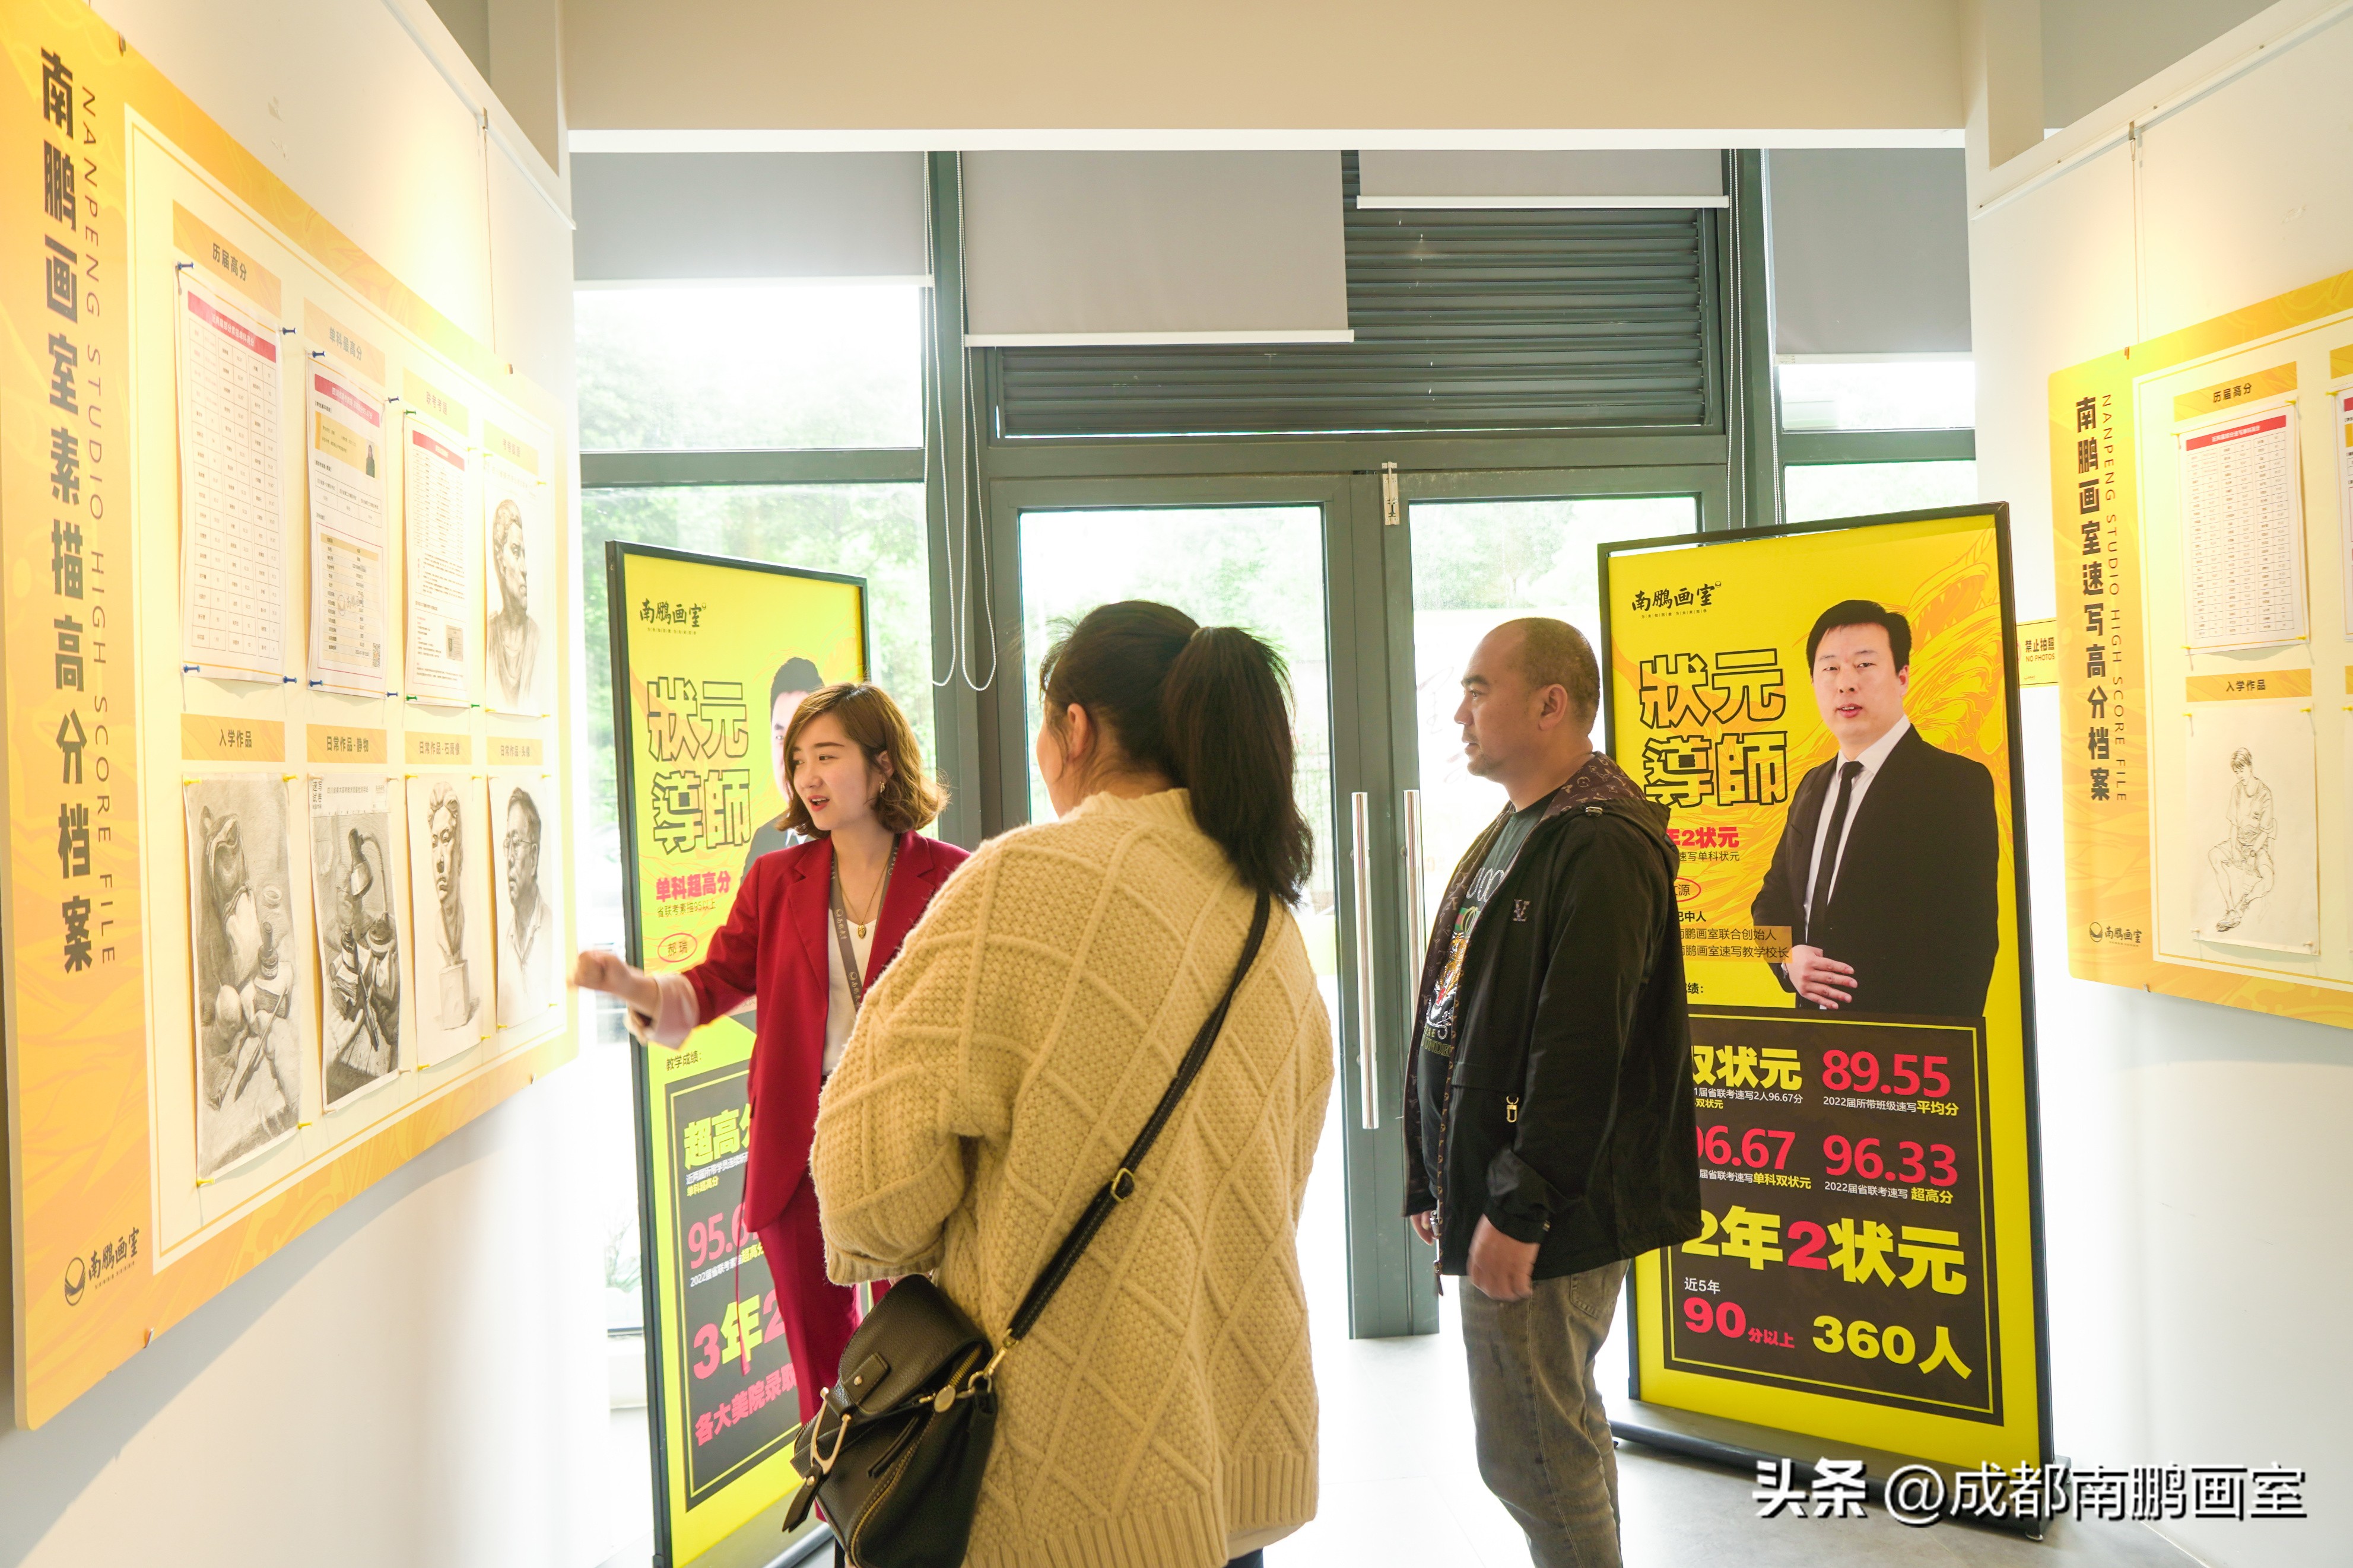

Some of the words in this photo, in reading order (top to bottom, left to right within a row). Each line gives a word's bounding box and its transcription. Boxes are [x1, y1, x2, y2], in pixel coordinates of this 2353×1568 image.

[82, 85, 100, 318] NANPENG
[212, 242, 247, 282] 历届高分
[329, 326, 363, 361] 单科最高分
[2213, 383, 2252, 403] 历届高分
[86, 345, 103, 521] STUDIO
[2102, 394, 2116, 501] NANPENG
[40, 47, 93, 975] 南鹏画室素描高分档案
[2107, 514, 2120, 596] STUDIO
[91, 551, 107, 664] HIGH
[639, 597, 702, 628] 南鹏画室
[1631, 583, 1715, 612] 南鹏画室
[2075, 396, 2110, 802] 南鹏画室速写高分档案
[2025, 637, 2055, 653] 禁止拍照
[2110, 609, 2122, 663] HIGH
[2034, 653, 2055, 661] PHOTOS
[2225, 679, 2266, 692] 入学作品
[2113, 676, 2125, 746] SCORE
[218, 729, 253, 749] 入学作品
[94, 695, 111, 843] SCORE
[2116, 759, 2127, 802] FILE
[1679, 851, 1740, 862] 速写单科状元
[656, 870, 731, 902] 单科超高分
[99, 873, 115, 964] FILE
[657, 899, 716, 918] 省联考素描95以上
[667, 940, 688, 957] 郝瑞
[2104, 925, 2142, 943] 南鹏画室
[1685, 982, 1704, 995] 绩：
[1691, 1045, 1802, 1091] 双状元
[1822, 1049, 1951, 1098] 89.55
[1695, 1098, 1724, 1109] 双状元
[1822, 1096, 1959, 1117] 2022届所带班级速写平均分
[1822, 1134, 1958, 1187] 96.33
[687, 1175, 719, 1197] 单科超高分
[88, 1226, 139, 1281] 南鹏画室
[688, 1202, 760, 1270] 95.6
[1681, 1205, 1967, 1295] 2年2状元
[1684, 1277, 1721, 1295] 近5年
[1812, 1315, 1973, 1380] 360人
